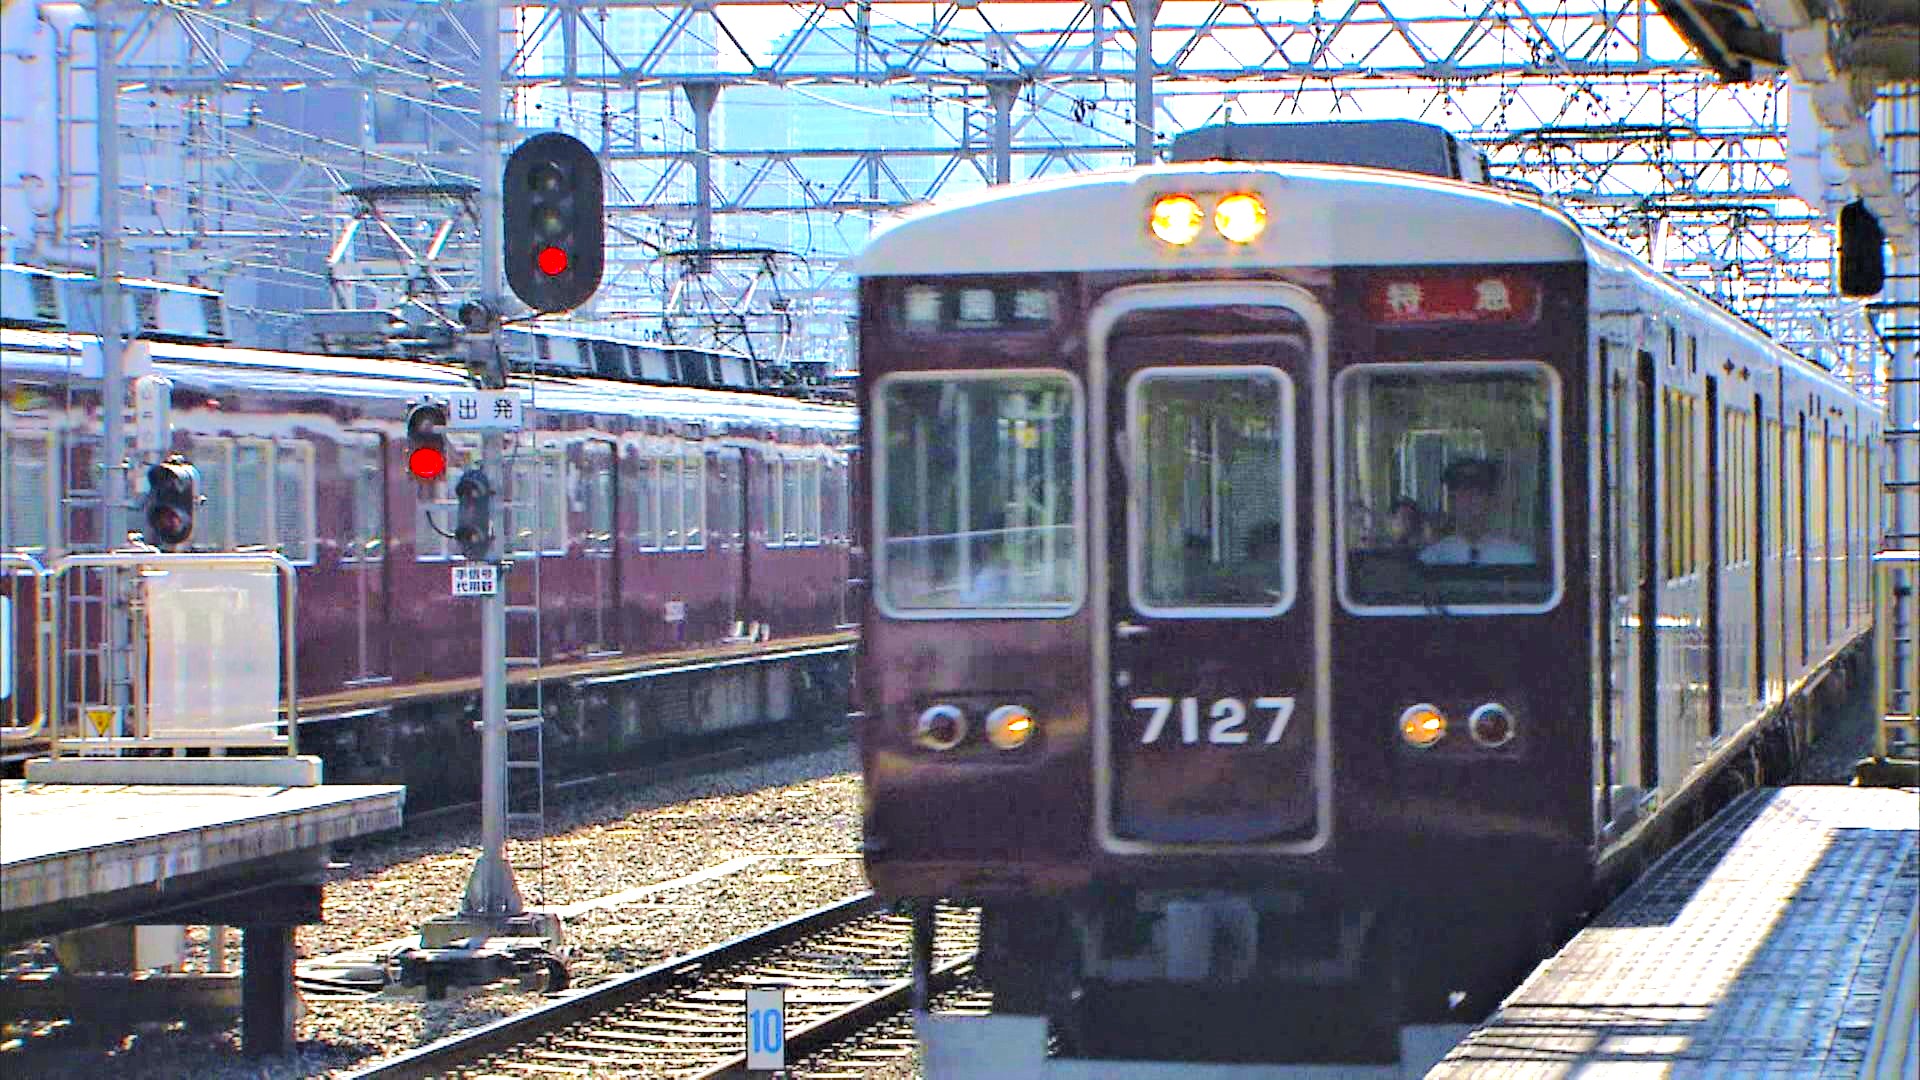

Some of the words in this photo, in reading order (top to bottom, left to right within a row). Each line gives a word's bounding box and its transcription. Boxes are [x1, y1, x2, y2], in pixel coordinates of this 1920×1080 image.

[458, 397, 513, 420] 出発
[1131, 696, 1296, 744] 7127
[749, 1007, 782, 1055] 10
